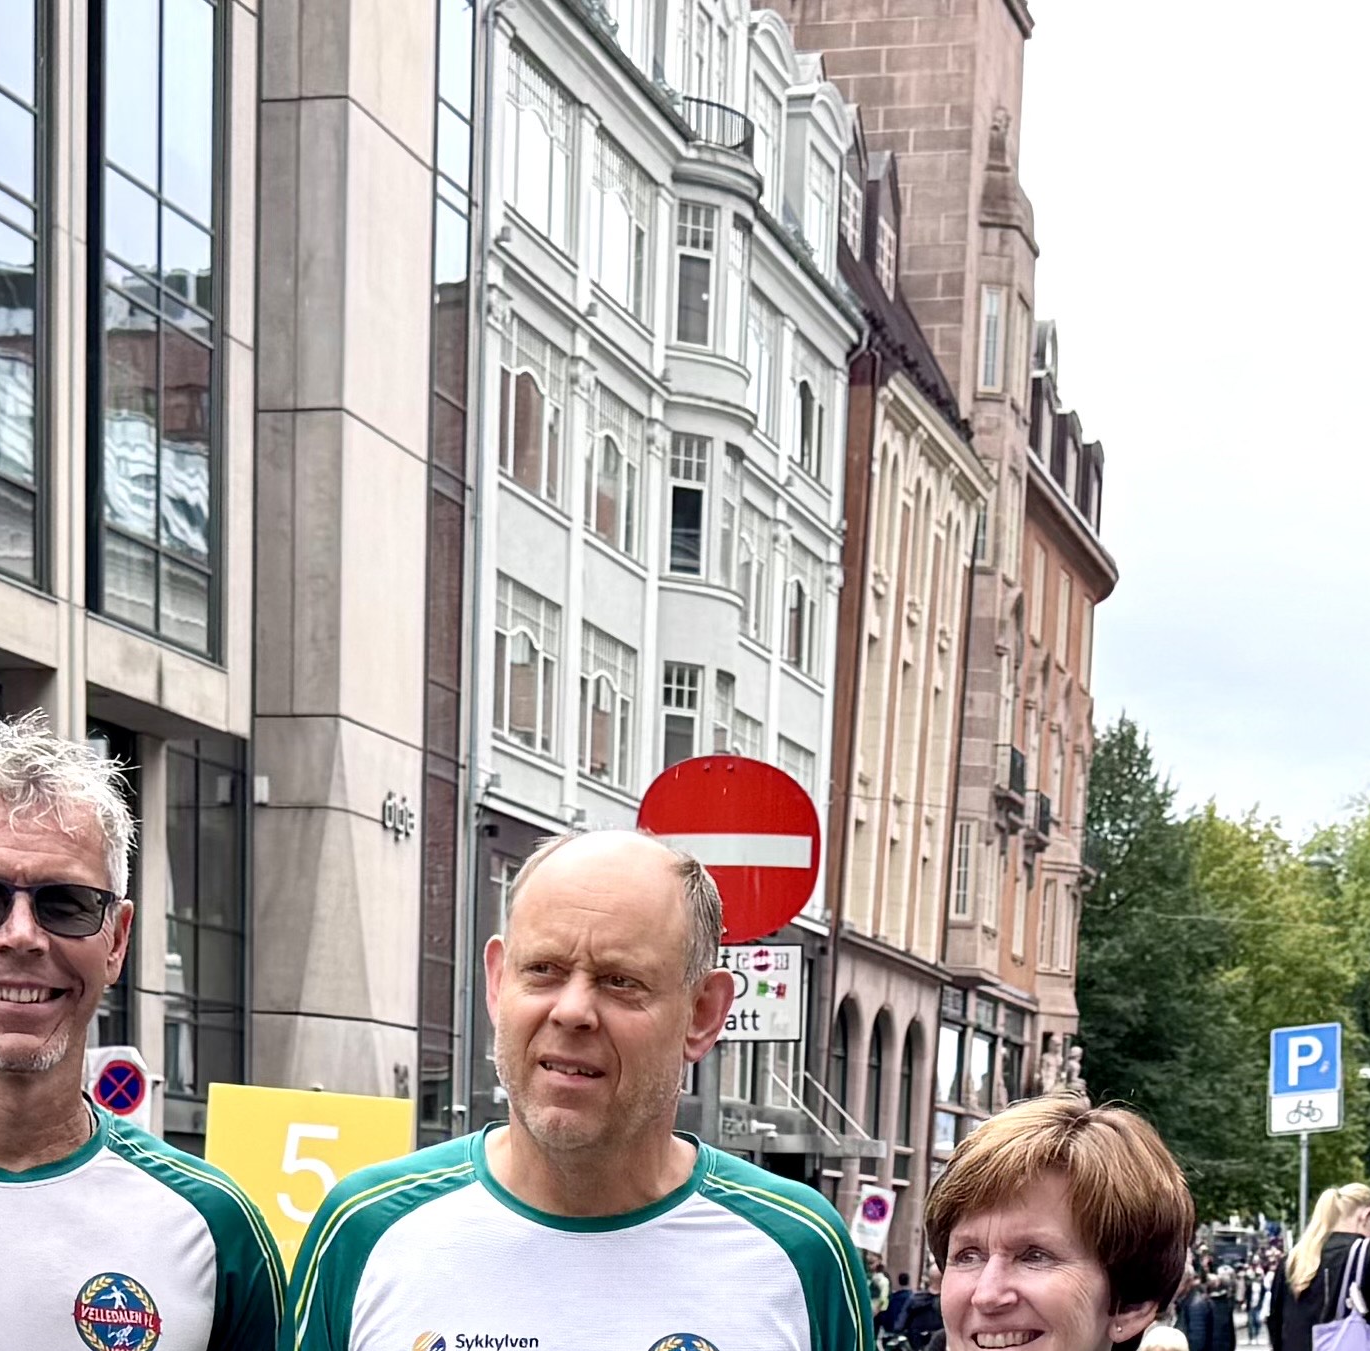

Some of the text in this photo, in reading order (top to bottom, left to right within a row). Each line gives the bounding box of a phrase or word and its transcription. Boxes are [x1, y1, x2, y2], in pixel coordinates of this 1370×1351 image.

[1287, 1036, 1323, 1087] P
[276, 1122, 340, 1224] 5
[80, 1304, 143, 1325] VELLEDALEN
[455, 1333, 539, 1351] Sykkylven
